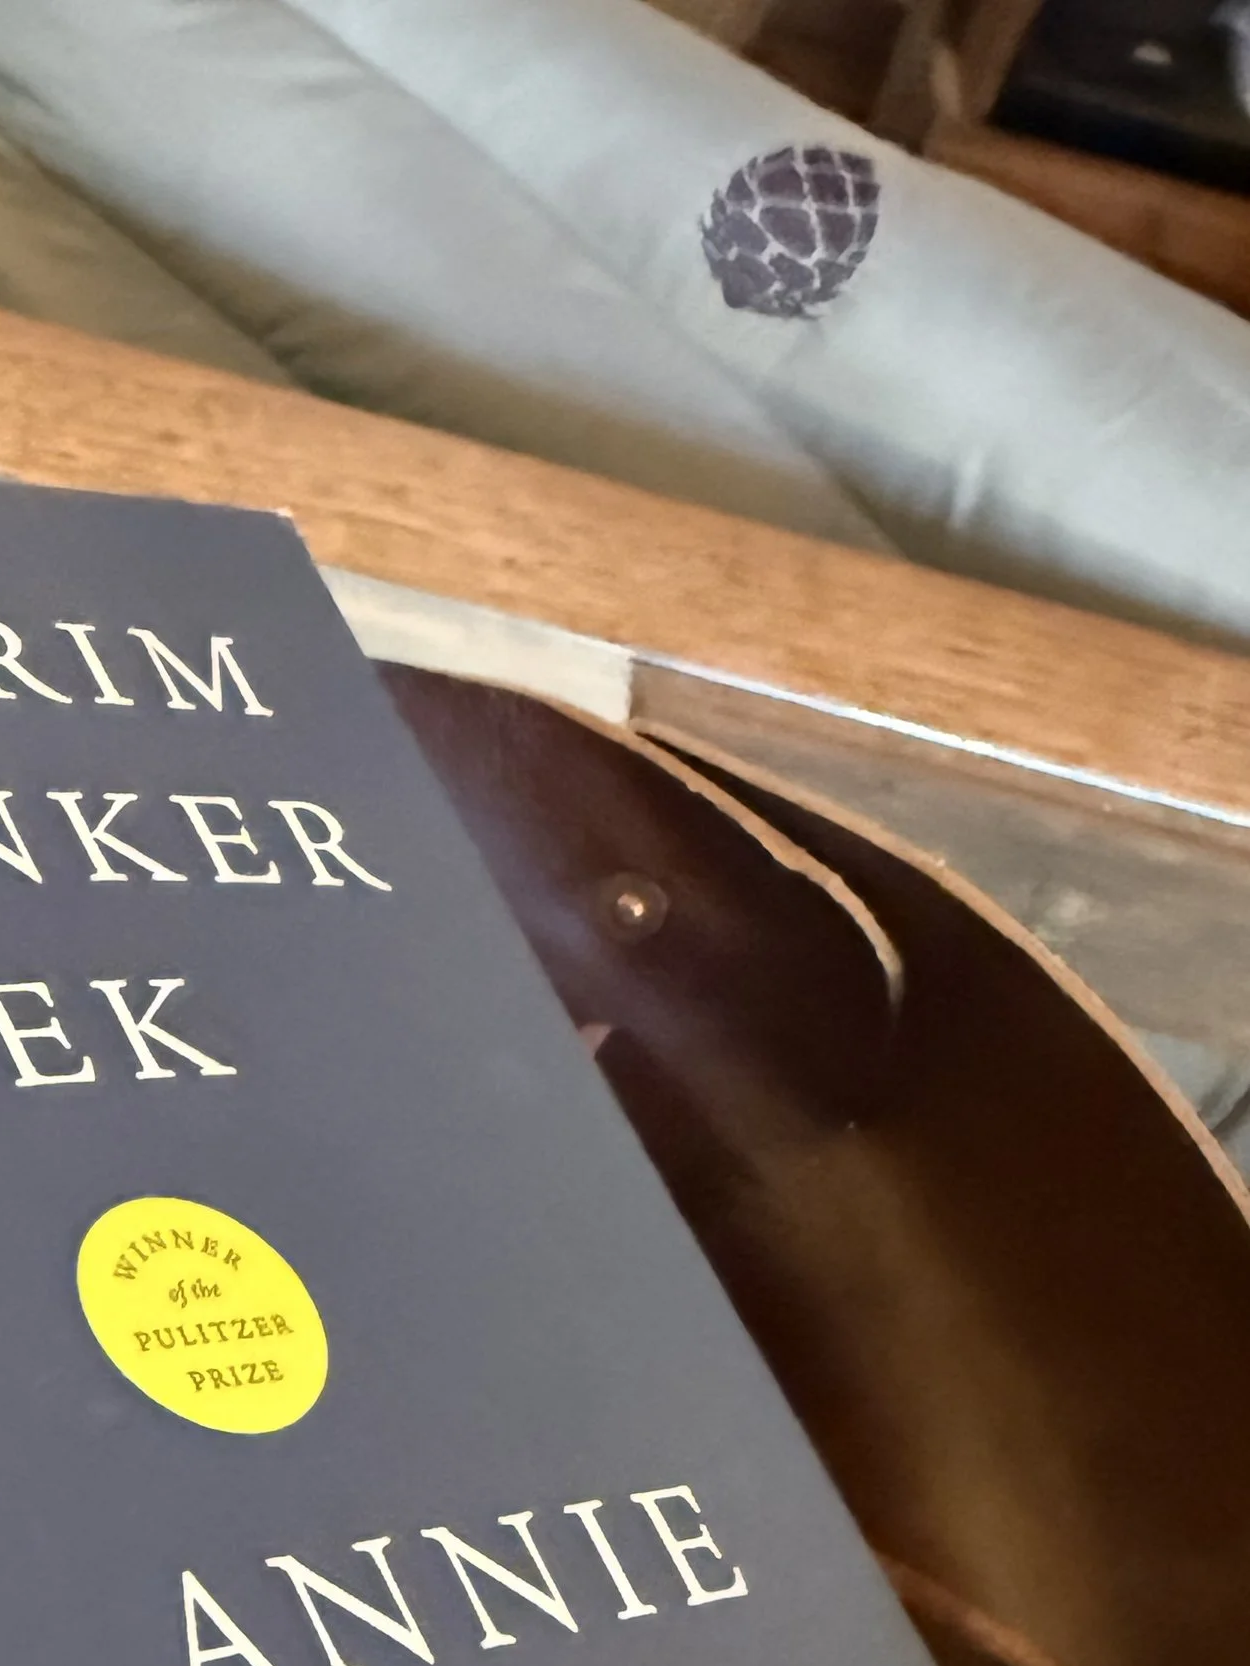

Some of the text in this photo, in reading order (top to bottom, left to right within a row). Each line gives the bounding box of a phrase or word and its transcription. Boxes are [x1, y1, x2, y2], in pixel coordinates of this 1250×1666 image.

[112, 1228, 243, 1282] WINNER
[168, 1277, 223, 1309] of the
[133, 1313, 295, 1352] PULITZER
[186, 1359, 285, 1393] PRIZE
